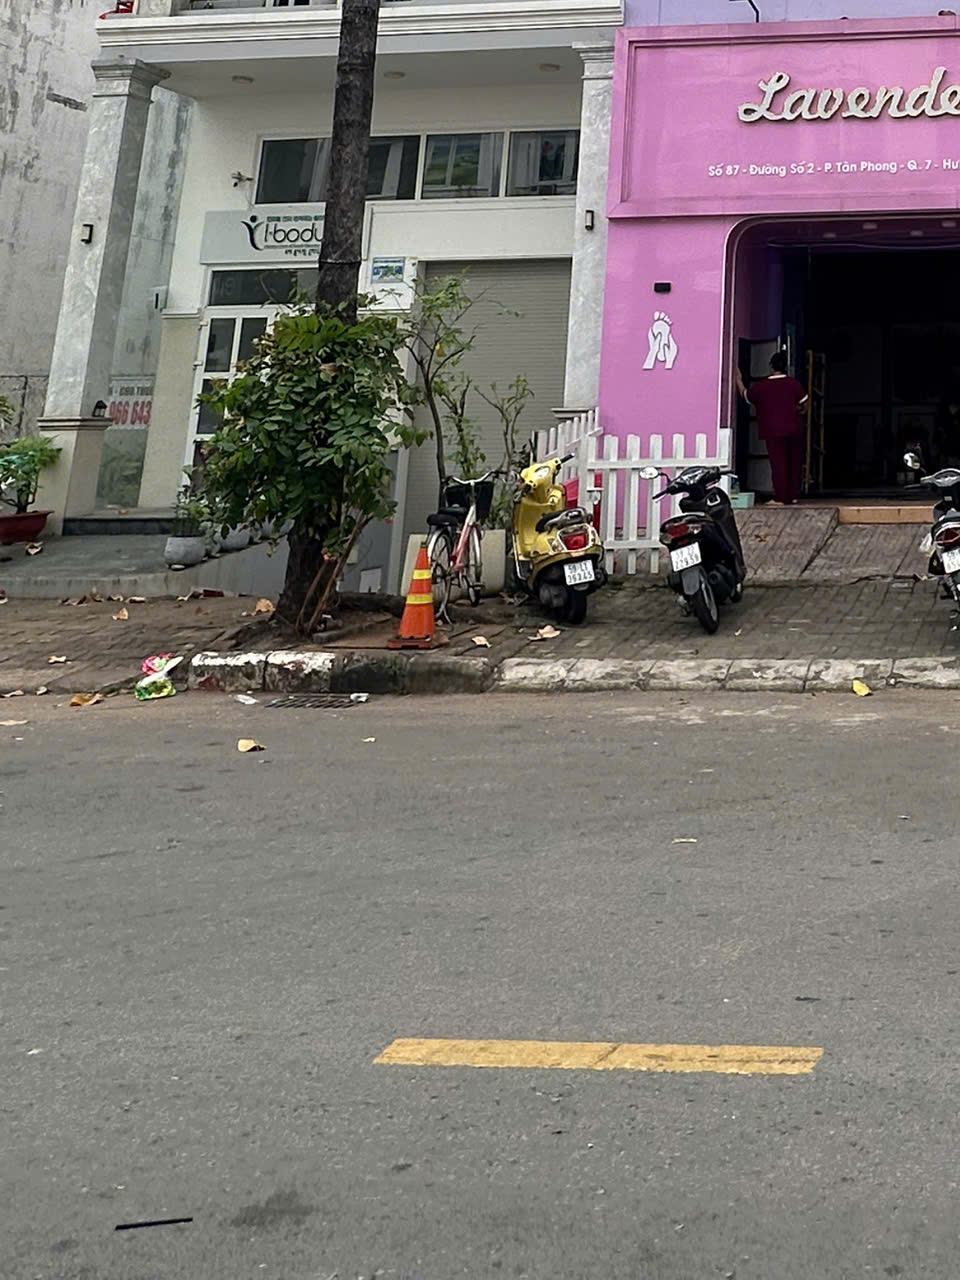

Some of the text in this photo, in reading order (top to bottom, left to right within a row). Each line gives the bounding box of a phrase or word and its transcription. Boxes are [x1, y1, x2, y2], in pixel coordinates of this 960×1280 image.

[708, 162, 724, 177] Số
[726, 164, 740, 176] 87
[790, 160, 806, 174] Số
[807, 162, 815, 174] 2
[860, 160, 897, 174] Phong
